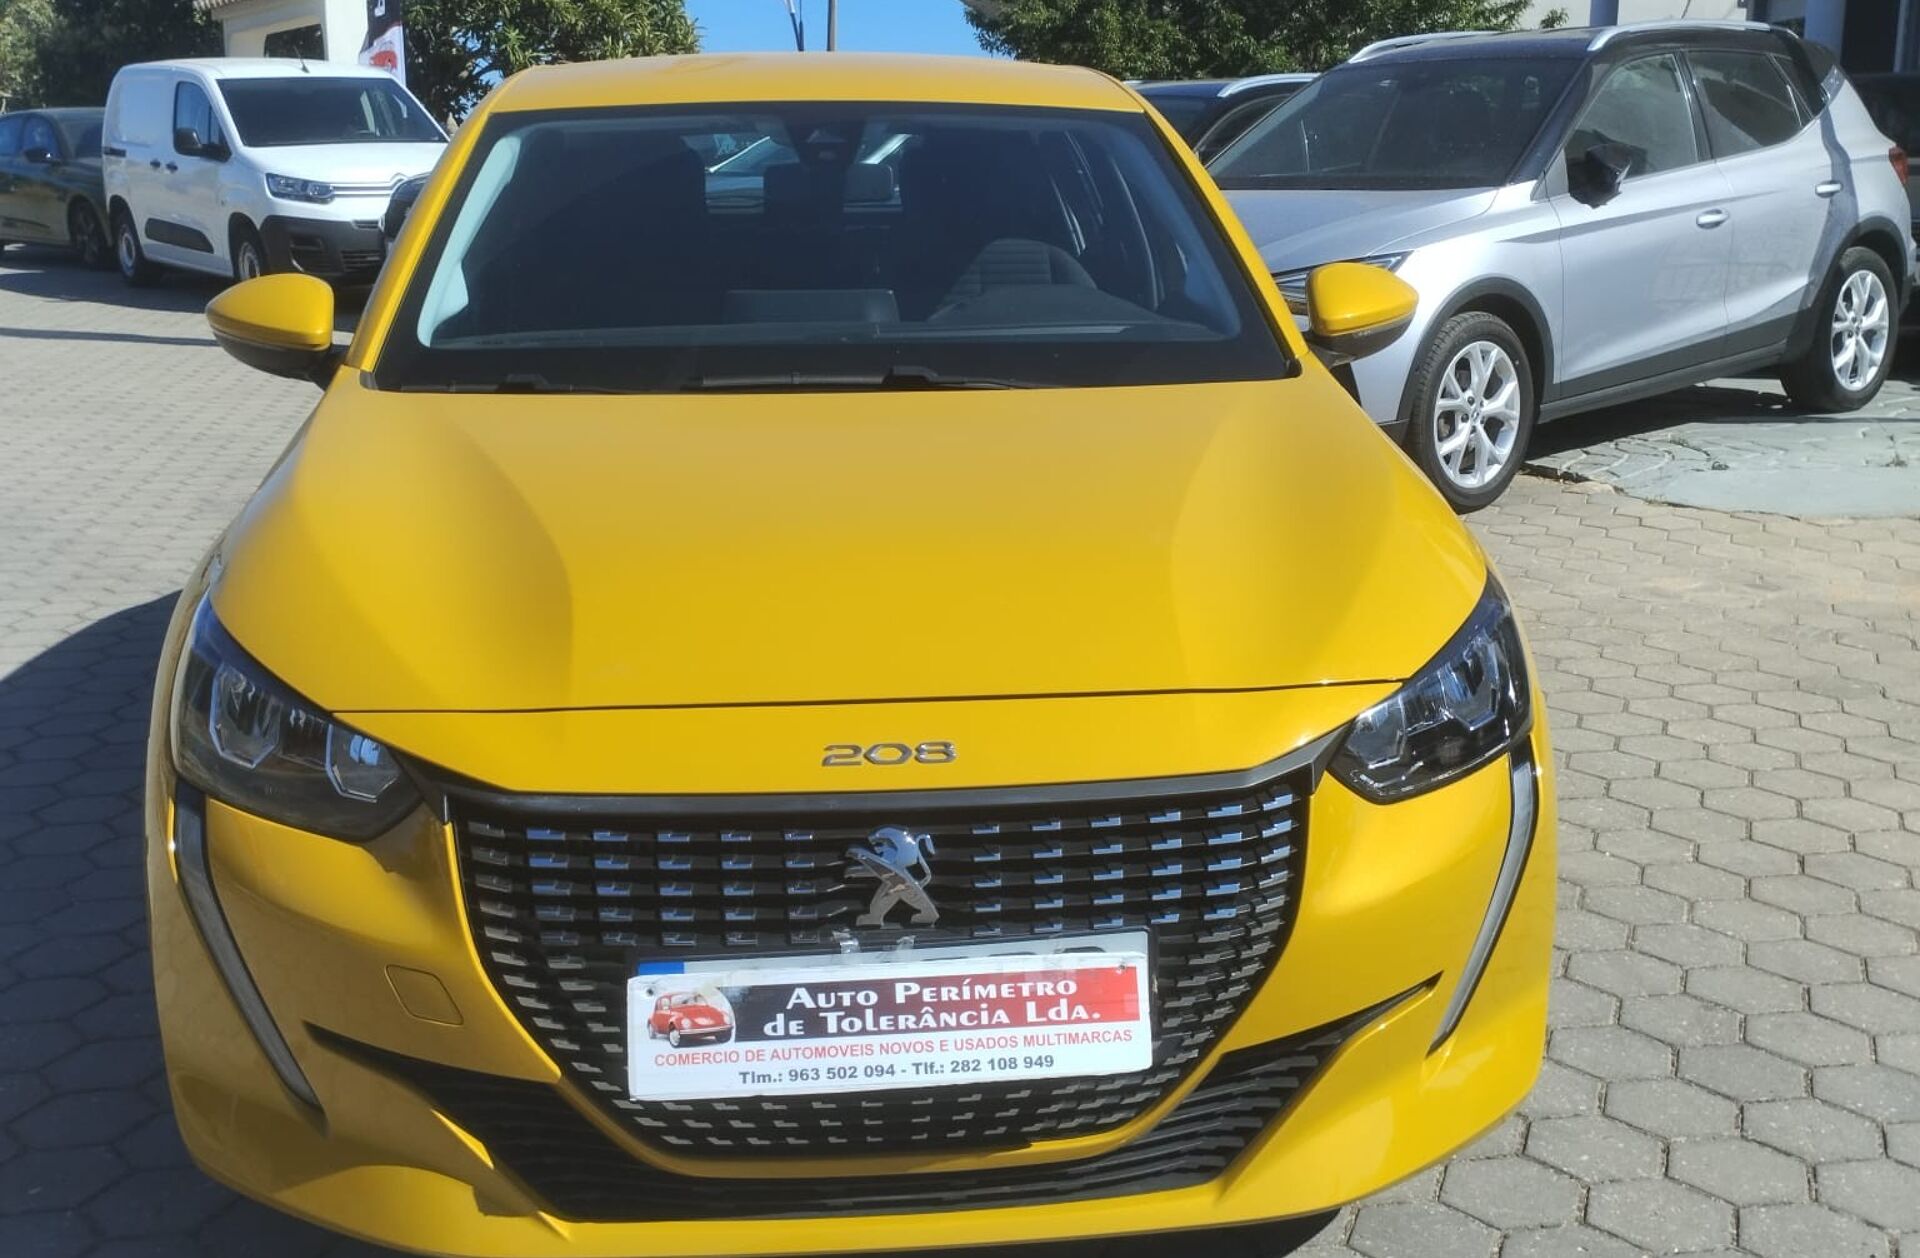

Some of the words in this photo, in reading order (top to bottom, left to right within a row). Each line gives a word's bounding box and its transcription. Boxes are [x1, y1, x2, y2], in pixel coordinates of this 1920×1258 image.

[822, 741, 957, 766] 208
[655, 1050, 739, 1067] COMERCIO
[745, 1049, 767, 1063] DE
[771, 1043, 874, 1061] AUTOMOVEIS
[880, 1040, 934, 1055] NOVOS
[939, 1039, 949, 1052] E
[954, 1036, 1018, 1051] USADOS
[1023, 1029, 1133, 1048] MULTIMARCAS
[738, 1071, 783, 1084] Tlm.:
[788, 1068, 820, 1082] 963
[826, 1066, 858, 1080] 502
[864, 1064, 895, 1078] 094
[912, 1060, 944, 1075] Tlf.:
[950, 1059, 982, 1073] 282
[987, 1057, 1018, 1071] 108
[1023, 1055, 1055, 1069] 949
